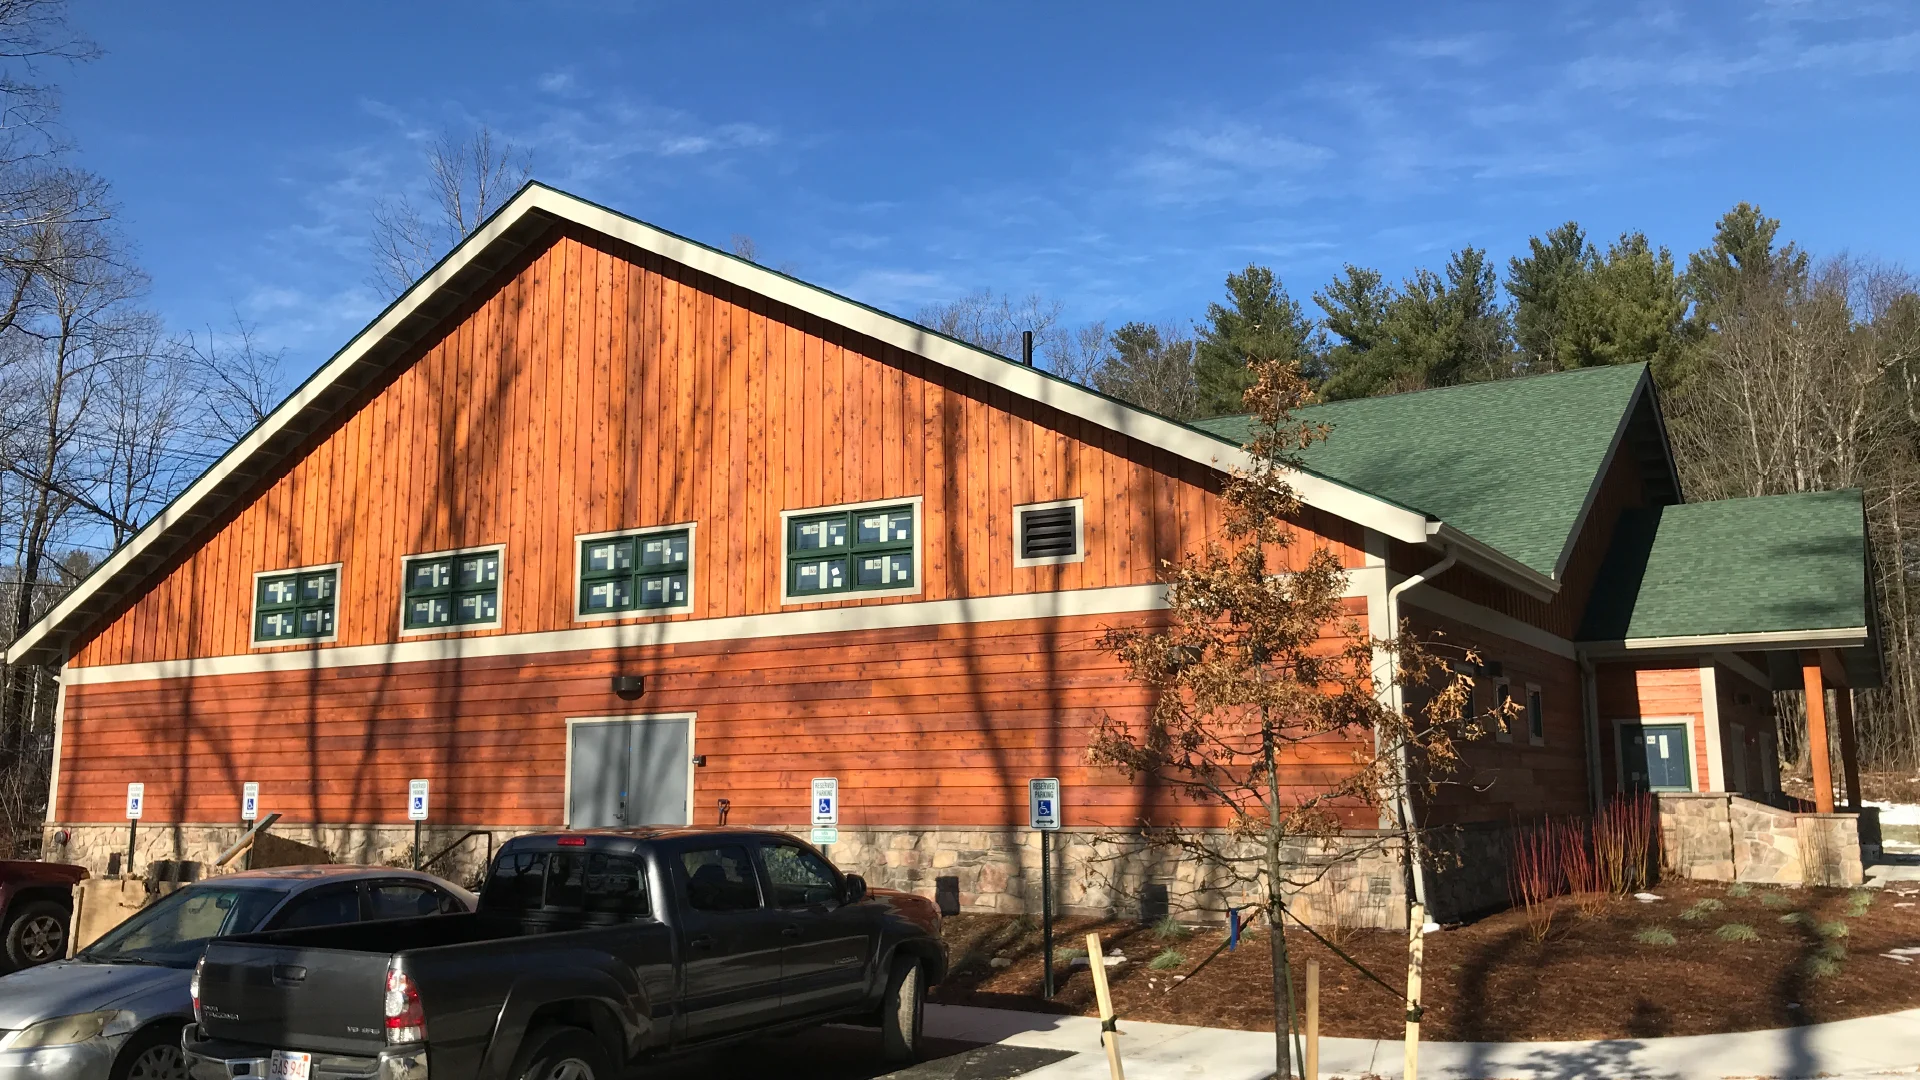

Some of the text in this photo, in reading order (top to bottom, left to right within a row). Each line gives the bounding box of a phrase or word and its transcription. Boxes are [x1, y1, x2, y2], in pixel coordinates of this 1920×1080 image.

[1032, 782, 1055, 790] RESERVED
[1034, 790, 1054, 798] PARKING
[289, 1060, 306, 1078] 941
